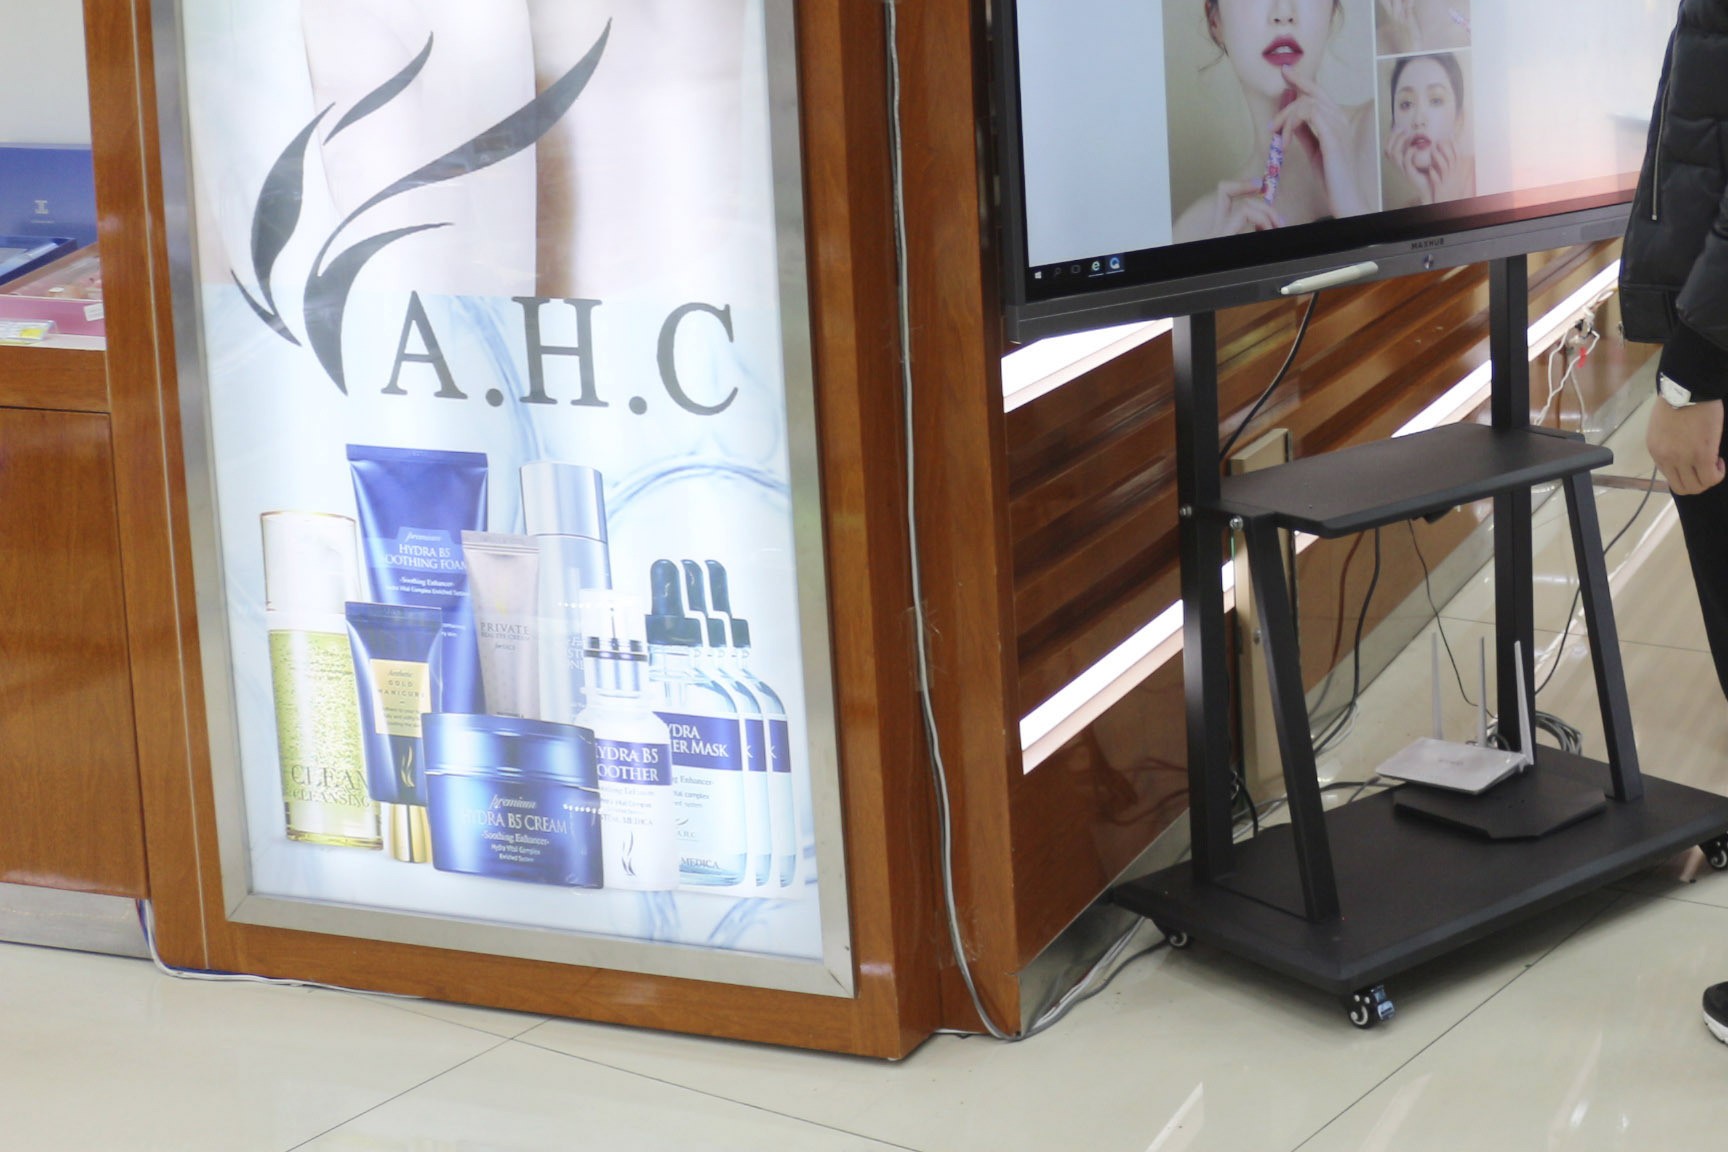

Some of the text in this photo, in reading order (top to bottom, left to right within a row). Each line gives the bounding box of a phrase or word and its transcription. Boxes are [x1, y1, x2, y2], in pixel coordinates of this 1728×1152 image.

[380, 290, 738, 416] A.H.C
[399, 543, 437, 558] HYDRA
[382, 553, 438, 569] OOTHING
[480, 622, 530, 635] PRIVATE
[667, 723, 701, 739] YDRA
[691, 741, 729, 758] MASK
[596, 763, 660, 782] OOTHER
[489, 793, 537, 809] premium
[524, 814, 568, 834] CREAM
